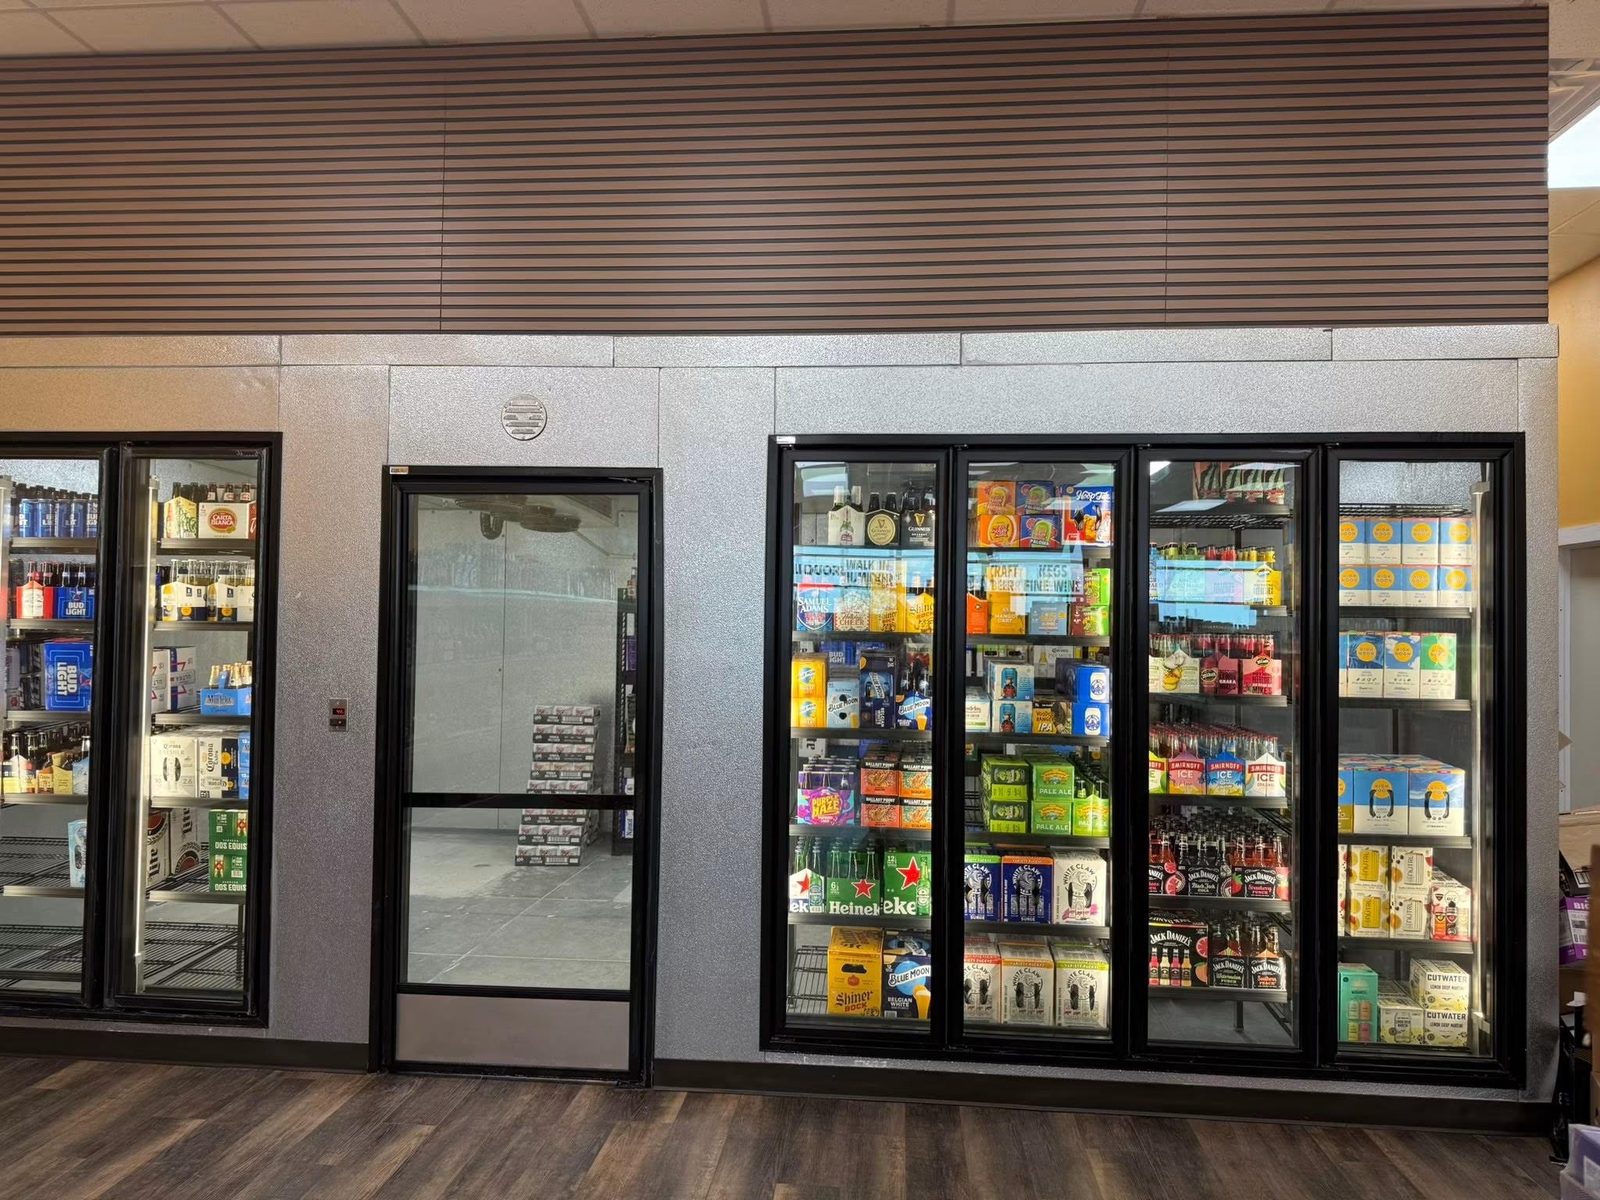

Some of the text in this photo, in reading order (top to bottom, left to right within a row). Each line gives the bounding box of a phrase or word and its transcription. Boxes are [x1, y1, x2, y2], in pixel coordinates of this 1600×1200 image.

[57, 662, 67, 696] LIGHT
[67, 665, 77, 692] BUD
[828, 702, 843, 712] BLUE
[843, 698, 859, 707] MOON
[1038, 723, 1052, 732] IPA
[1171, 762, 1200, 770] SMIRNOFF
[1210, 762, 1240, 770] SMIRNOFF
[1251, 765, 1281, 773] SMIRNOFF
[1177, 770, 1193, 778] ICE
[1217, 770, 1232, 778] ICE
[812, 802, 839, 816] HAZE
[972, 864, 990, 874] CLAW
[1012, 864, 1041, 884] WHITE CLAW
[1063, 864, 1095, 884] WHITE CLAW
[1188, 871, 1201, 881] JACK
[1244, 873, 1256, 883] JACK
[1150, 930, 1192, 947] JACK DANIEL'S
[971, 965, 988, 974] CLAW
[1213, 962, 1226, 971] JACK
[1251, 964, 1264, 974] JACK
[889, 966, 930, 985] BLUE MOON
[1013, 968, 1040, 986] WHITE CLAW
[1067, 970, 1094, 988] WHITE CLAW
[1427, 974, 1467, 982] CUTWATER
[836, 990, 873, 1006] Shiner
[845, 1002, 868, 1012] BOCK
[1427, 1012, 1466, 1020] CUTWATER
